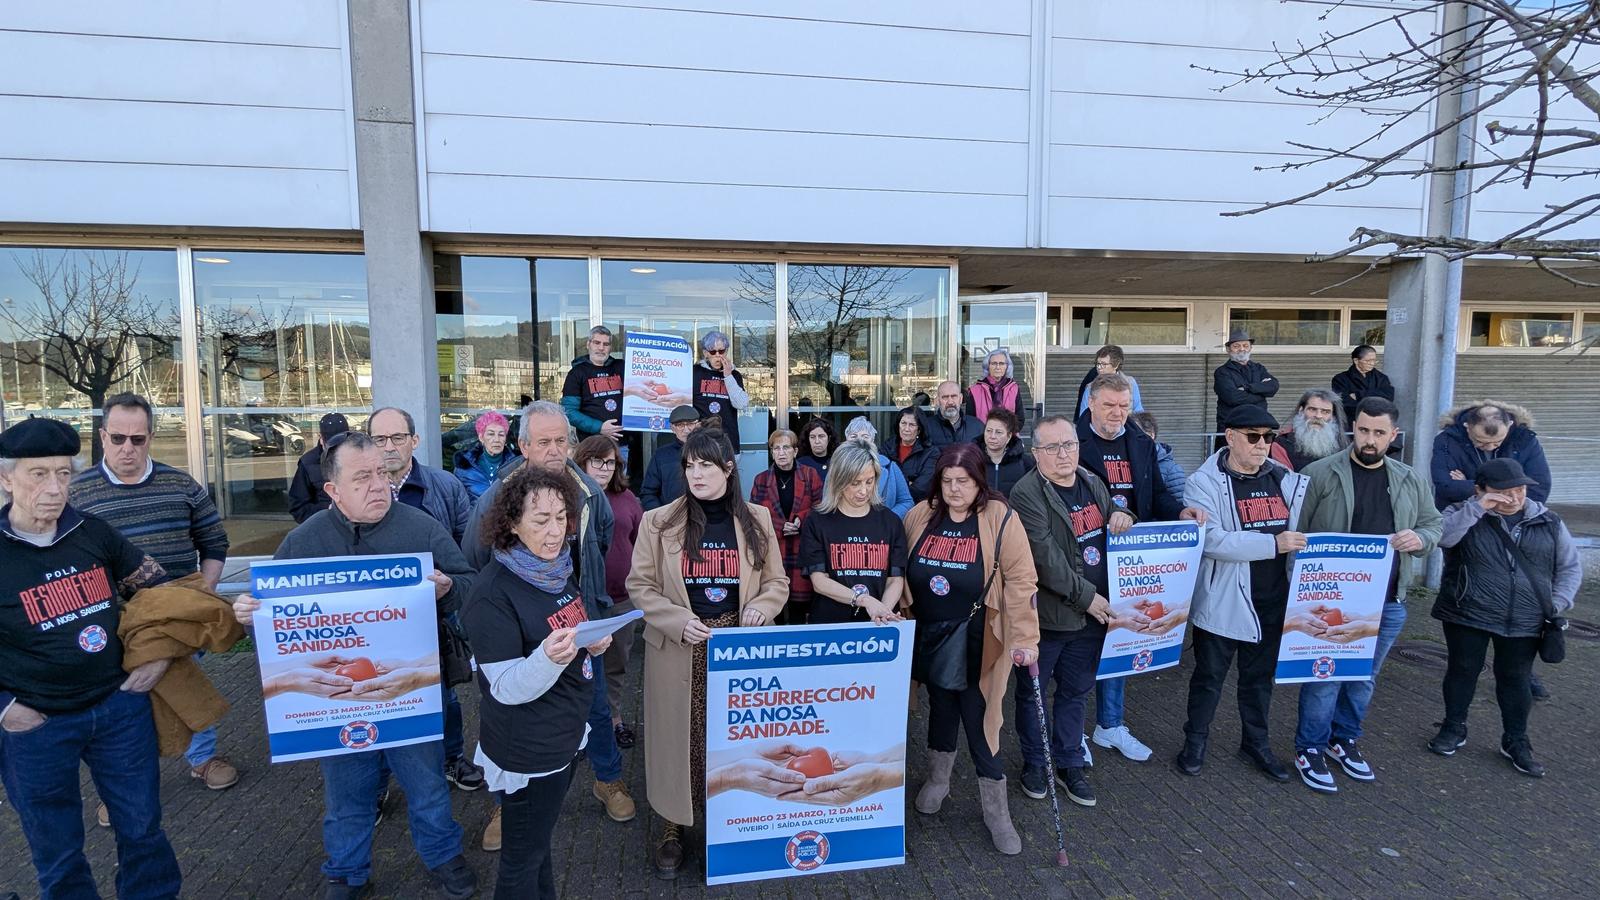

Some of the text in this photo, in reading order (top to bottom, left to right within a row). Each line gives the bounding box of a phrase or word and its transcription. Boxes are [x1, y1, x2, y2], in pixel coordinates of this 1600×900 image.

[628, 337, 688, 350] MANIFESTACIÓN
[632, 350, 651, 358] POLA
[632, 356, 683, 367] RESURRECCIÓN
[1109, 531, 1197, 546] MANIFESTACIÓN
[829, 540, 890, 570] RESURRECCIÓN
[1117, 555, 1145, 566] POLA
[45, 566, 77, 580] POLA
[1118, 560, 1188, 577] RESURRECCIÓN
[1301, 563, 1324, 572] POLA
[256, 565, 418, 590] MANIFESTACIÓN
[1118, 575, 1161, 588] DA NOSA
[1300, 570, 1372, 583] RESURRECCIÓN
[19, 563, 112, 625] RESURRECCIÓN
[1298, 582, 1339, 592] DA NOSA
[1297, 591, 1344, 602] SANIDADE.
[272, 602, 322, 618] POLA
[273, 605, 407, 631] RESURRECCIÓN
[40, 621, 55, 631] DA
[56, 612, 79, 626] NOSA
[275, 626, 357, 643] DA NOSA
[277, 637, 370, 655] SANIDADE.
[714, 637, 894, 662] MANIFESTACIÓN
[728, 676, 782, 693] POLA
[728, 682, 876, 709] RESURRECCIÓN
[285, 710, 328, 720] DOMINGO
[727, 705, 818, 725] DA NOSA
[727, 719, 830, 741] SANIDADE.
[726, 815, 774, 826] DOMINGO
[789, 810, 826, 819] MARZO,
[856, 803, 884, 813] MAÑÁ
[738, 824, 769, 833] VIVEIRO
[777, 820, 800, 829] SAÍDA
[836, 814, 874, 823] VERMELLA
